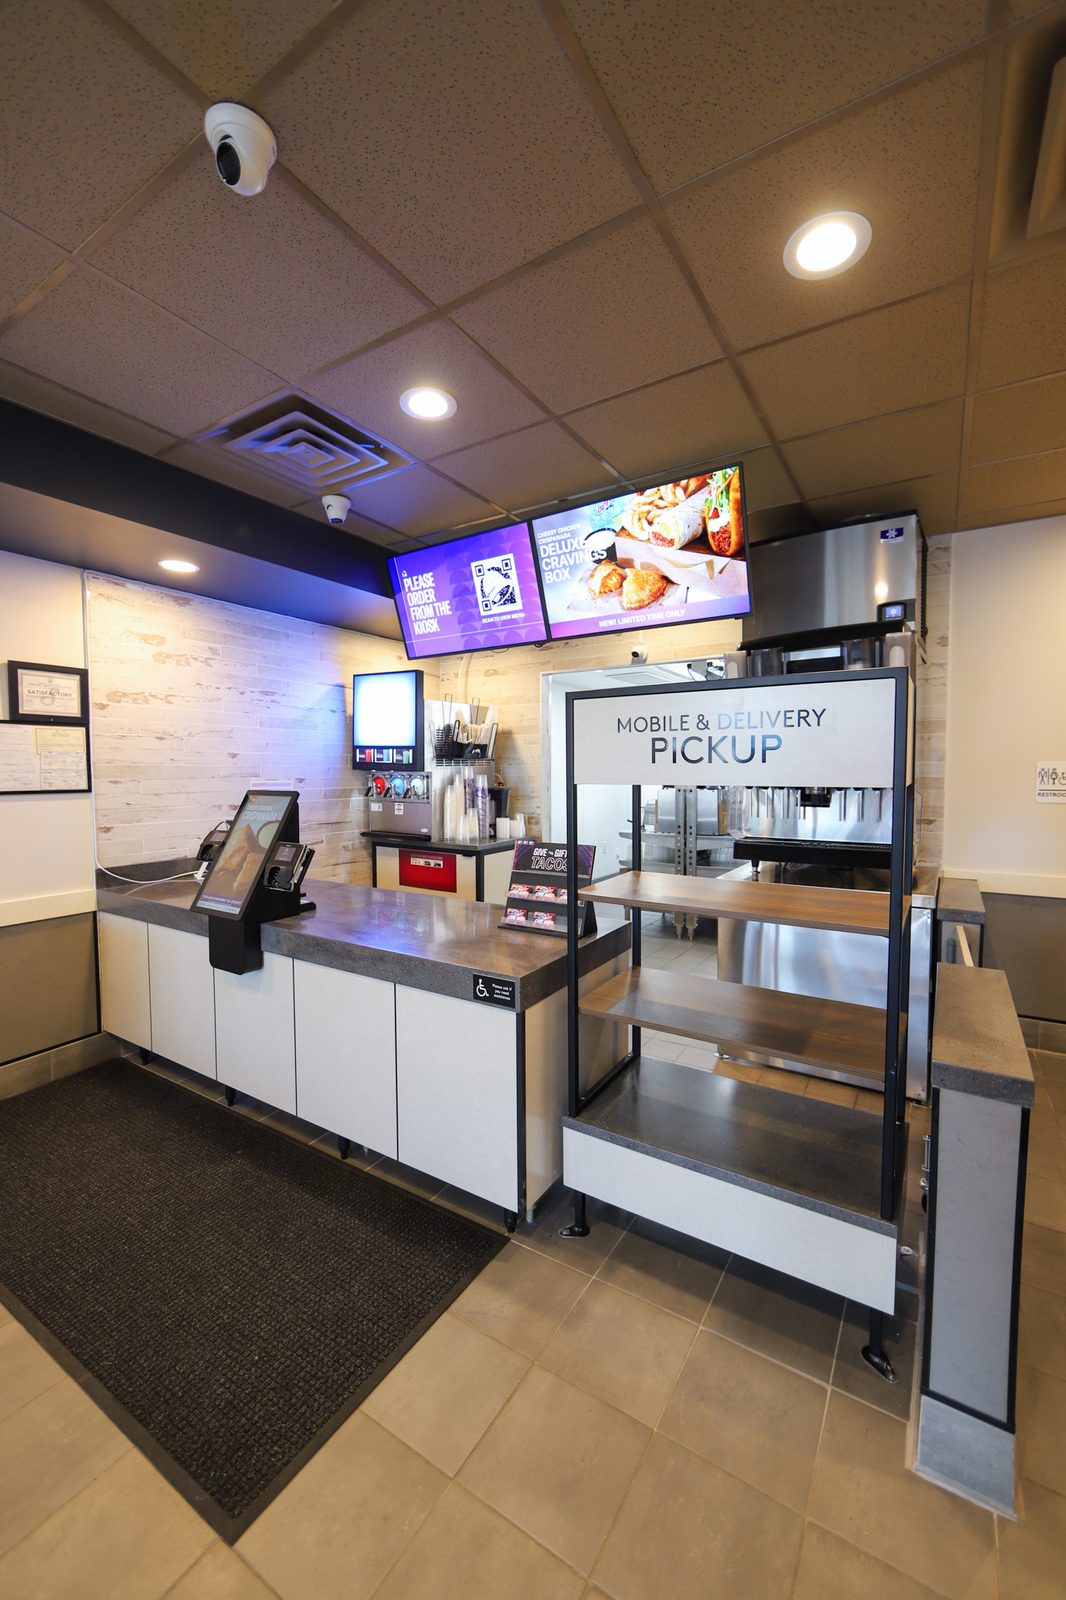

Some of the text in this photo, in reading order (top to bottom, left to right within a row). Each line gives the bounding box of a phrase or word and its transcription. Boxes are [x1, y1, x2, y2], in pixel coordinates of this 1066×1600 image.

[542, 548, 607, 571] CRAVINGS
[403, 572, 436, 592] PLEASE
[545, 567, 572, 584] BOX
[406, 588, 437, 607] ORDER
[410, 600, 452, 621] FROM THE
[599, 609, 686, 628] NEW! LIMITED TIME ONLY
[413, 618, 440, 635] KIOSK
[27, 689, 73, 698] SATISFACTORY
[617, 708, 827, 733] MOBILE & DELIVERY
[651, 734, 783, 764] PICKUP
[533, 848, 548, 857] GIVE
